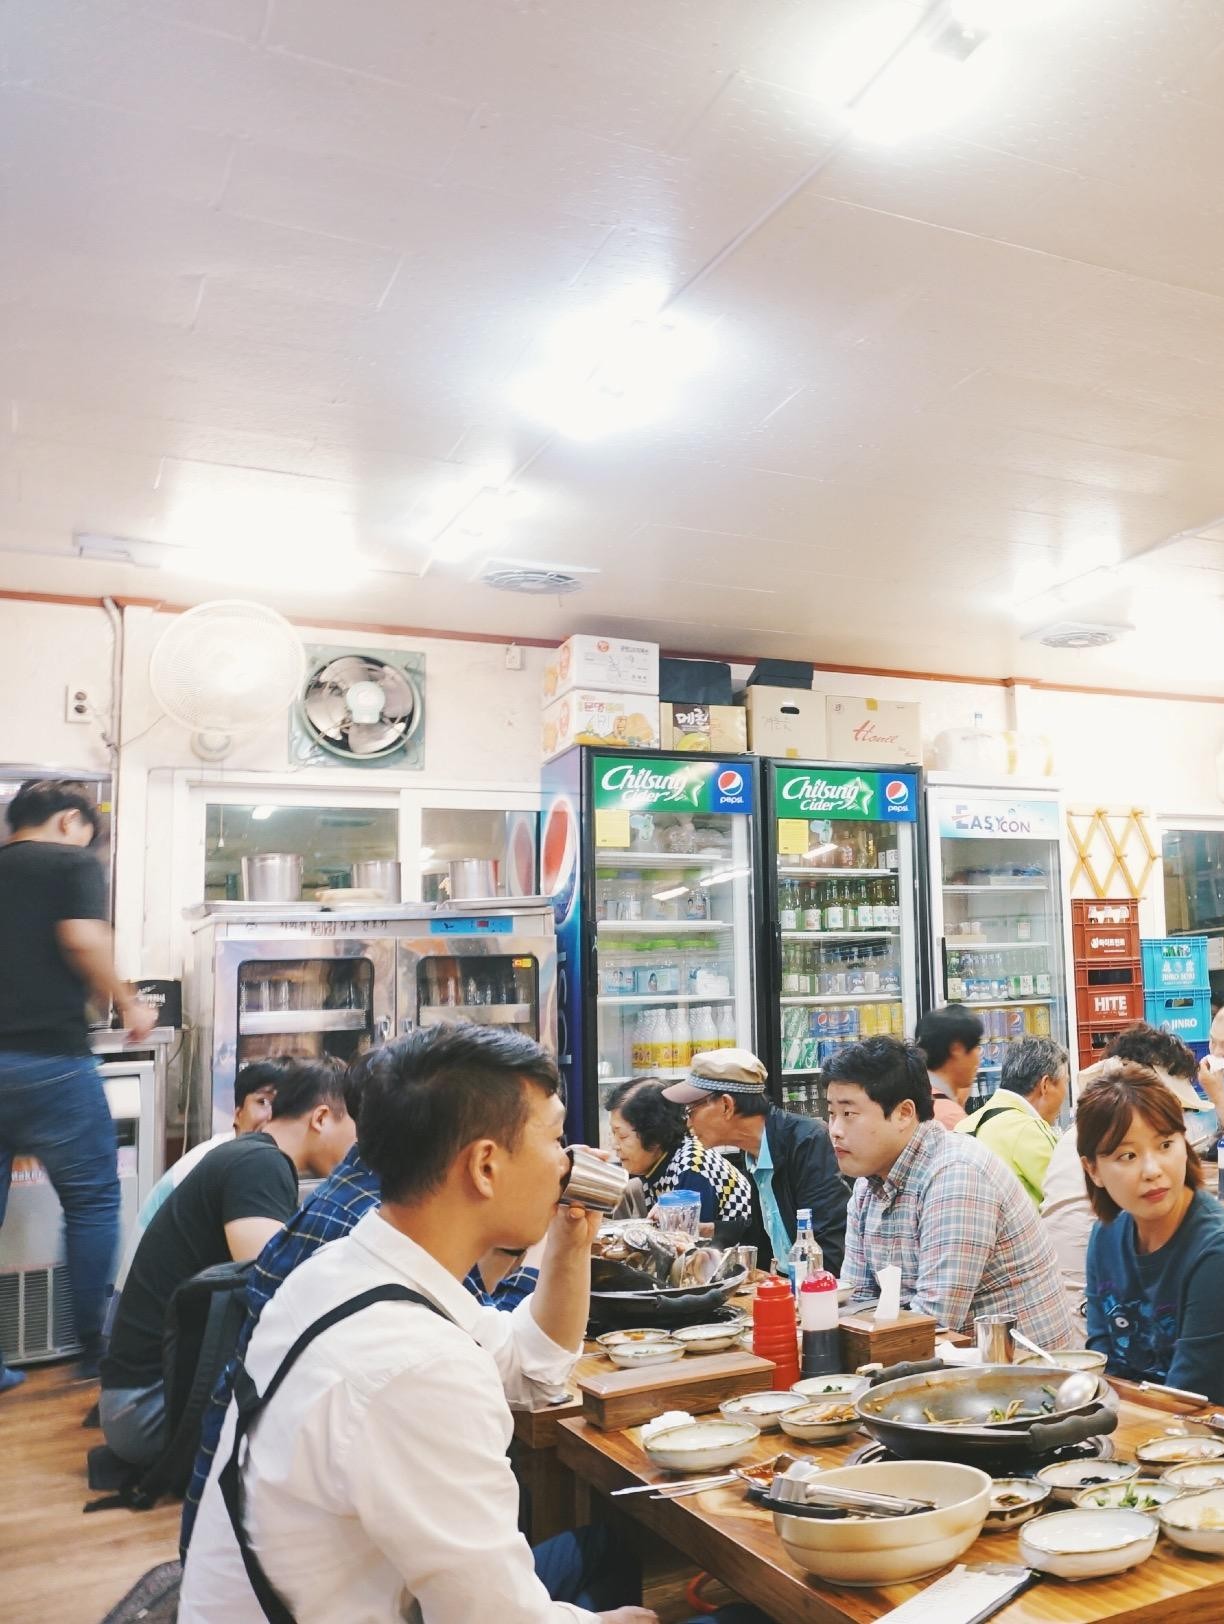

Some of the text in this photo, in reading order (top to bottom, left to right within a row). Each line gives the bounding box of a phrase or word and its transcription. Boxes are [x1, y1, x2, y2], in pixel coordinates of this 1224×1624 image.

[601, 765, 689, 800] Chilsung
[622, 789, 670, 803] Cider
[719, 796, 744, 804] pepsi
[782, 776, 861, 810] Chilsung
[800, 799, 843, 811] Cider
[1094, 996, 1127, 1012] HITE
[1171, 1018, 1198, 1030] JINRO
